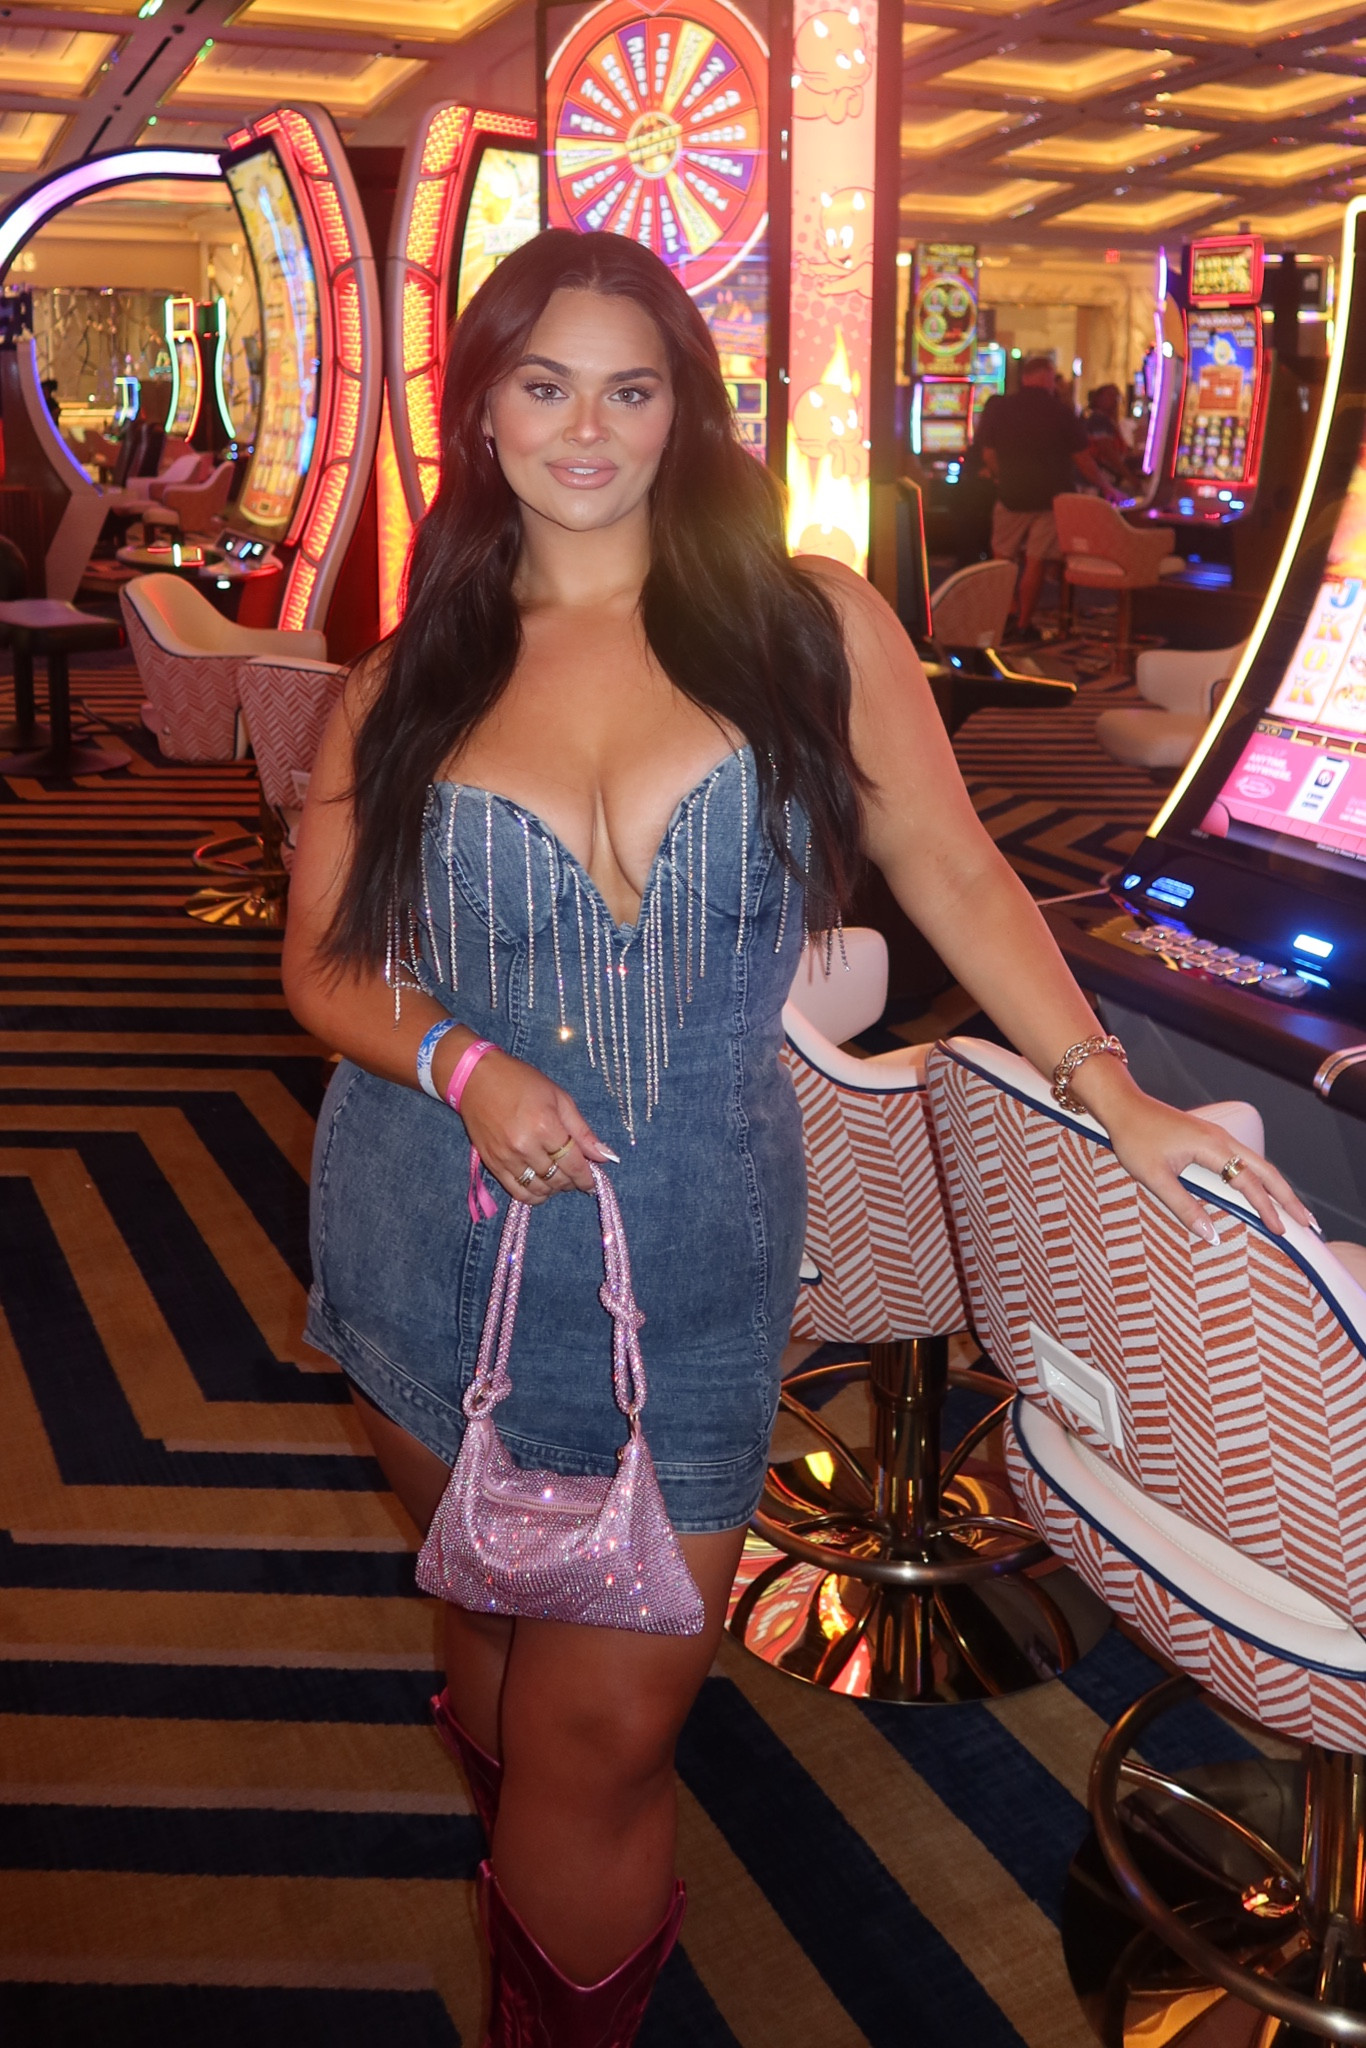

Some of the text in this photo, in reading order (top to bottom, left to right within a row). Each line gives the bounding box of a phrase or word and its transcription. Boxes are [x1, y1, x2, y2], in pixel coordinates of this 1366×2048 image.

[1329, 577, 1361, 609] J
[1314, 613, 1352, 642] K
[1286, 675, 1325, 705] K
